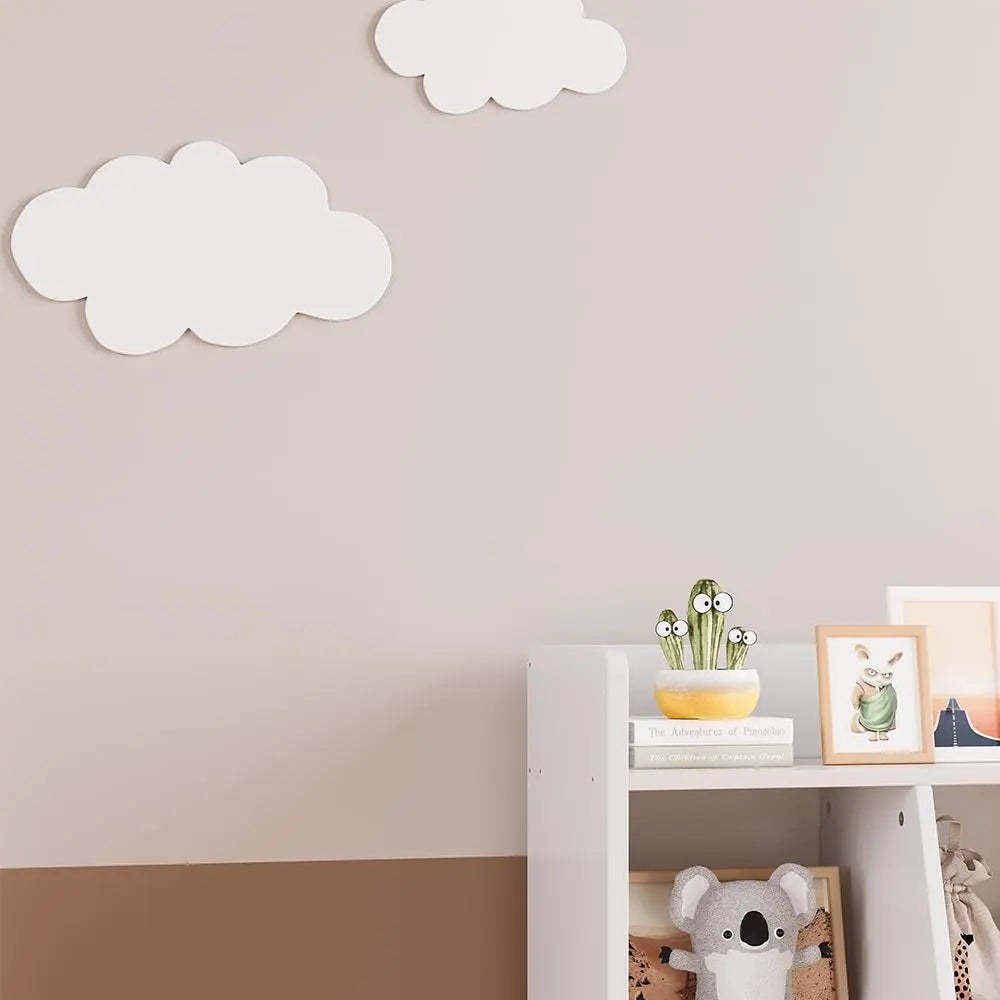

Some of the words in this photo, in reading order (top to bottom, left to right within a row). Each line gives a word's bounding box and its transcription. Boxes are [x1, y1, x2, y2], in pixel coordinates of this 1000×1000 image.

[649, 727, 665, 736] The
[671, 727, 722, 737] Adventures
[728, 727, 737, 736] of
[650, 753, 664, 761] The
